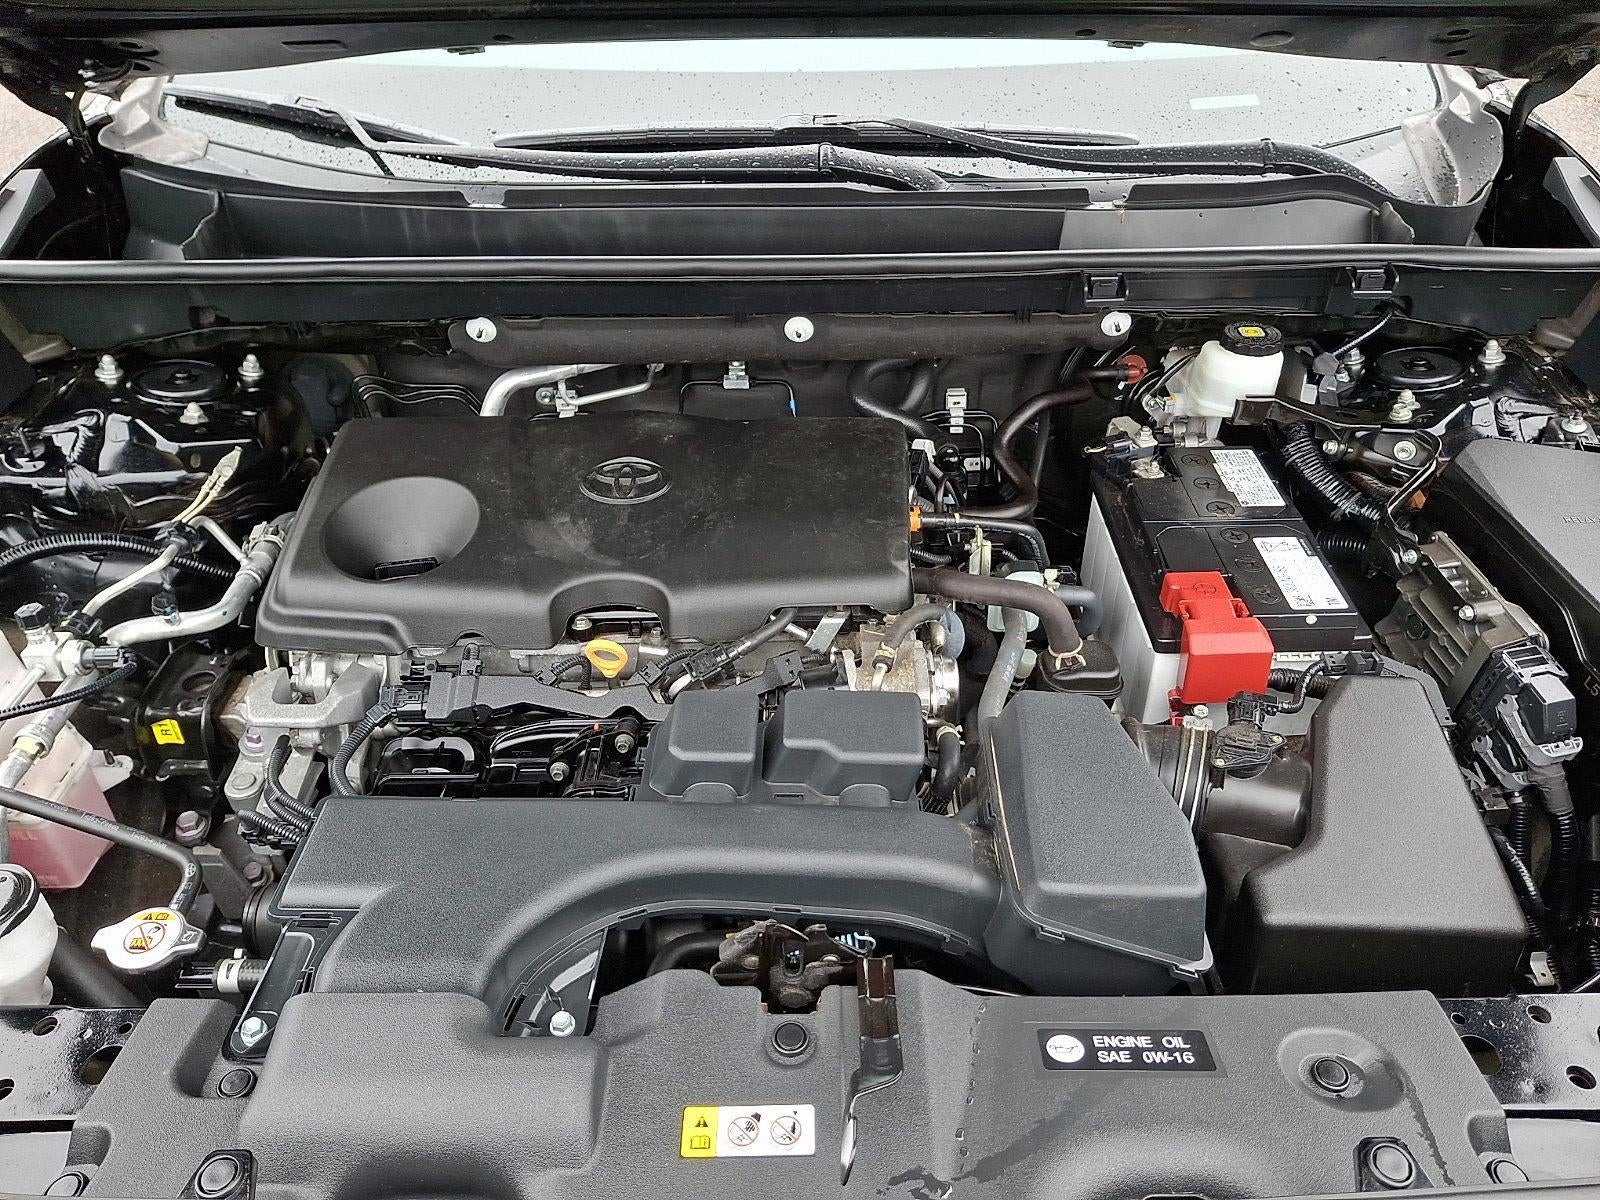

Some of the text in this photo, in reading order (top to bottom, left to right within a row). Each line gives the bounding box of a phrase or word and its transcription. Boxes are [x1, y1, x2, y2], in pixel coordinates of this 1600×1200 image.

[1092, 1035, 1192, 1049] ENGINE OIL
[1097, 1050, 1196, 1064] SAE 0W-16
